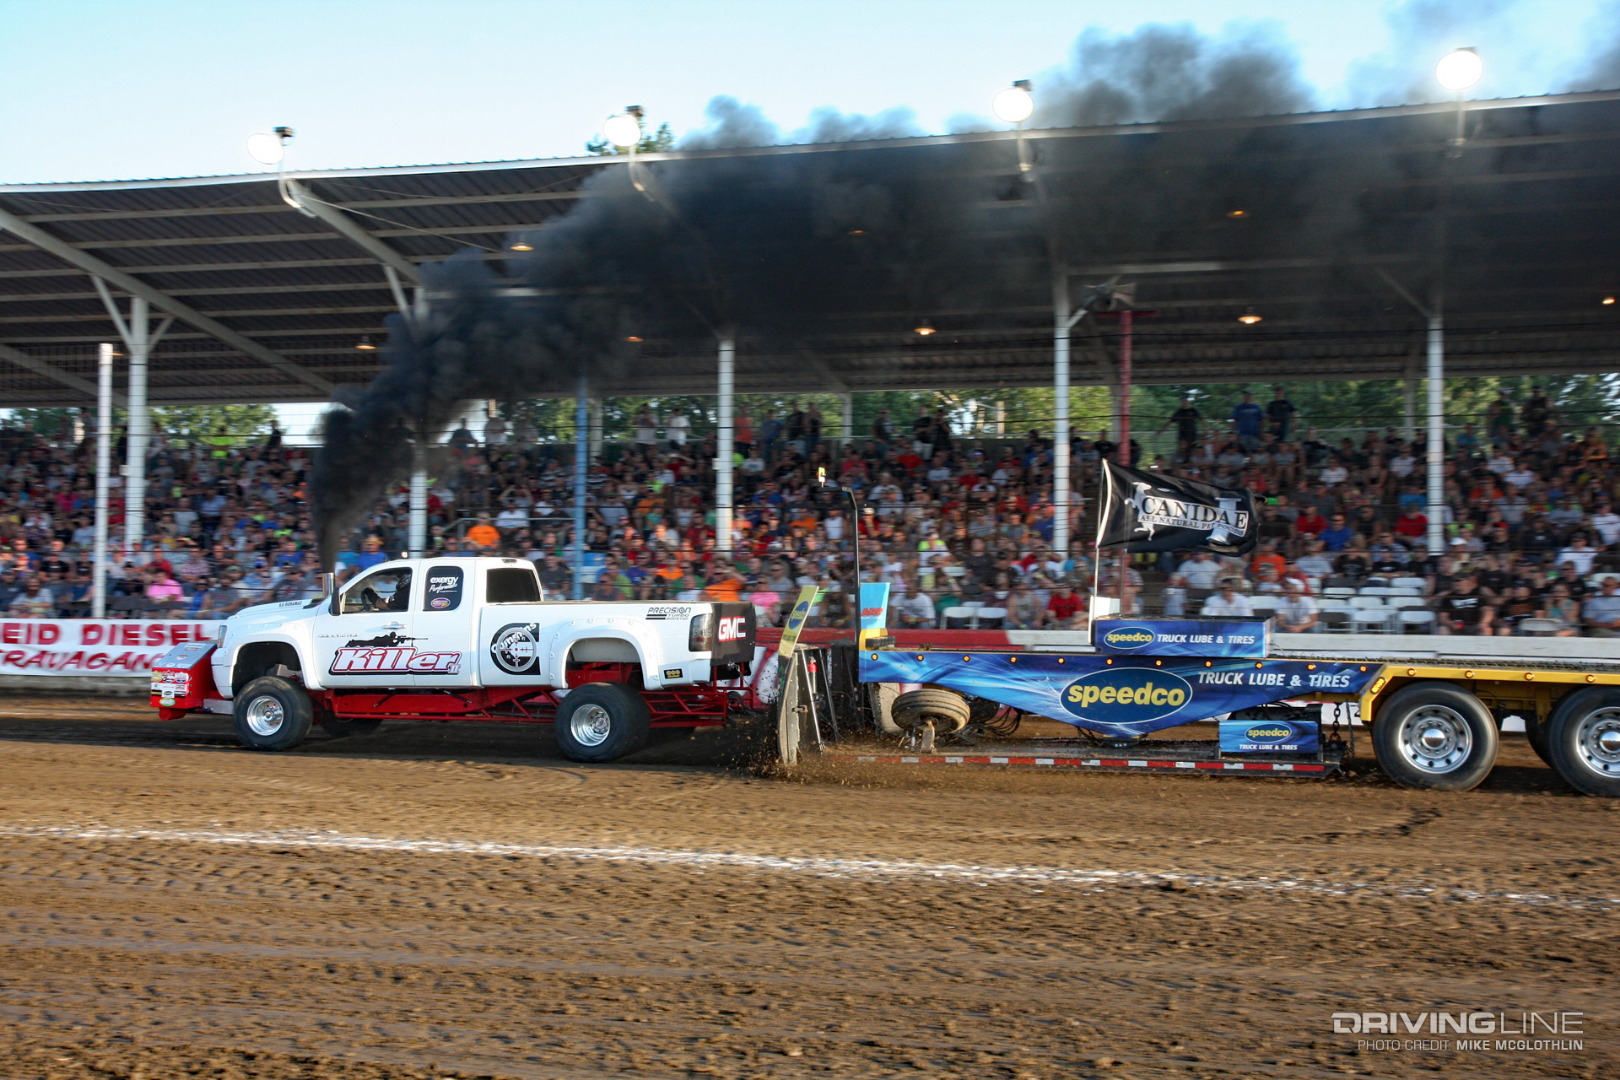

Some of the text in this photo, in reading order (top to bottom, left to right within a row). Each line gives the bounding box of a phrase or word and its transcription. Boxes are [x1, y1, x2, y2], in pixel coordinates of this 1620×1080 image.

[1141, 497, 1248, 529] CANIDAE
[1160, 517, 1199, 529] NATURAL
[430, 576, 458, 585] exergy
[648, 606, 691, 614] PRECISION
[81, 622, 212, 646] DIESEL
[718, 616, 747, 641] GMC
[1107, 632, 1255, 644] speedco TRUCK LUBE & TIRES
[0, 649, 165, 671] RAVAGAN
[332, 648, 461, 671] Killer
[1067, 671, 1350, 707] speedco TRUCK LUBE & TIRES
[1248, 728, 1290, 738] speedco
